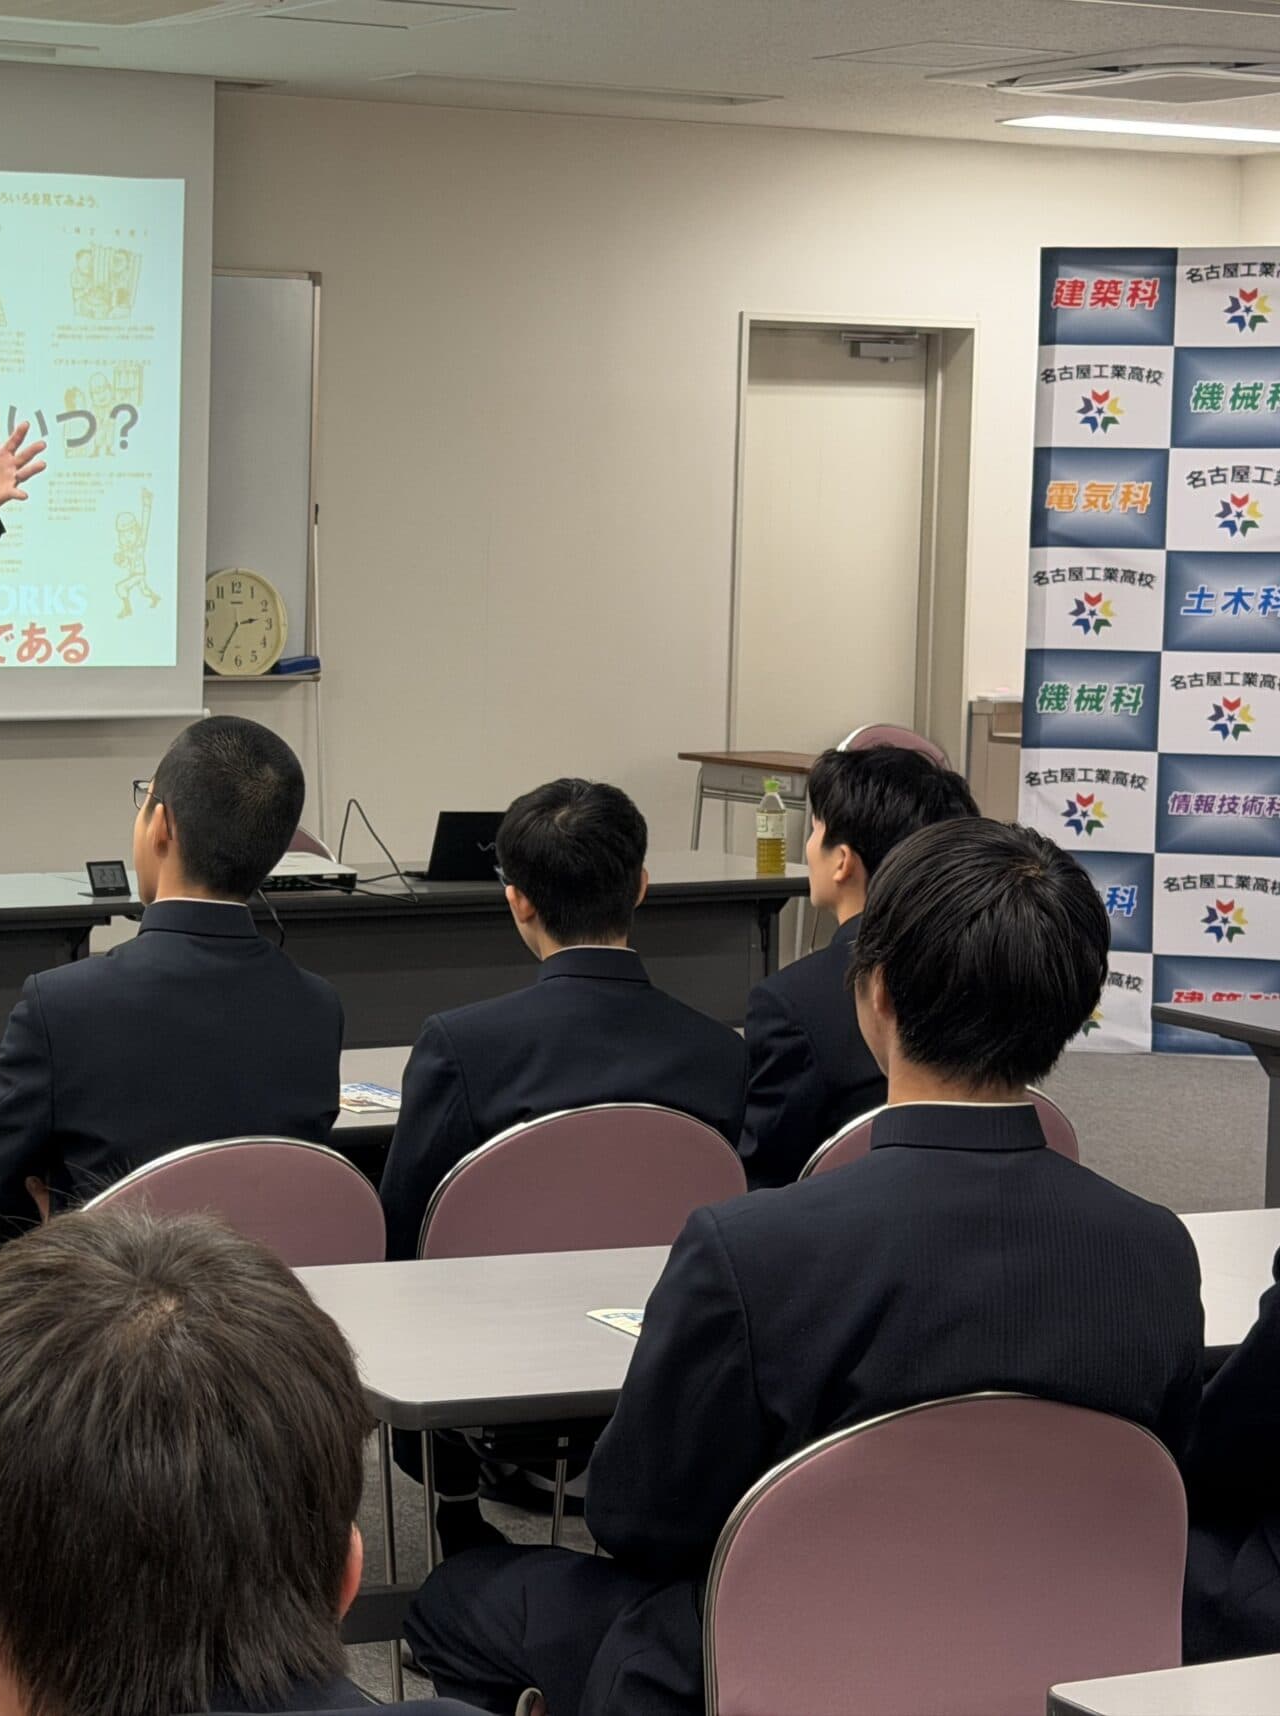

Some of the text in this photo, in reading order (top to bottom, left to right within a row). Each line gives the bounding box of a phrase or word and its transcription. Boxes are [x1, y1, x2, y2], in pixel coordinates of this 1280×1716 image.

[1186, 262, 1280, 283] 名古屋工業
[1053, 279, 1159, 309] 建築科
[1040, 364, 1164, 386] 名古屋工業高校
[1045, 481, 1152, 513] 電気科
[231, 580, 242, 594] 12
[1032, 566, 1156, 590] 名古屋工業高校
[216, 586, 225, 599] 11
[261, 599, 269, 613] 2
[265, 617, 273, 631] 3
[234, 654, 242, 667] 6
[250, 649, 258, 662] 5
[1170, 671, 1280, 691] 名古屋工業高
[1036, 681, 1144, 715] 機械科
[1025, 767, 1149, 792] 名古屋工業高校
